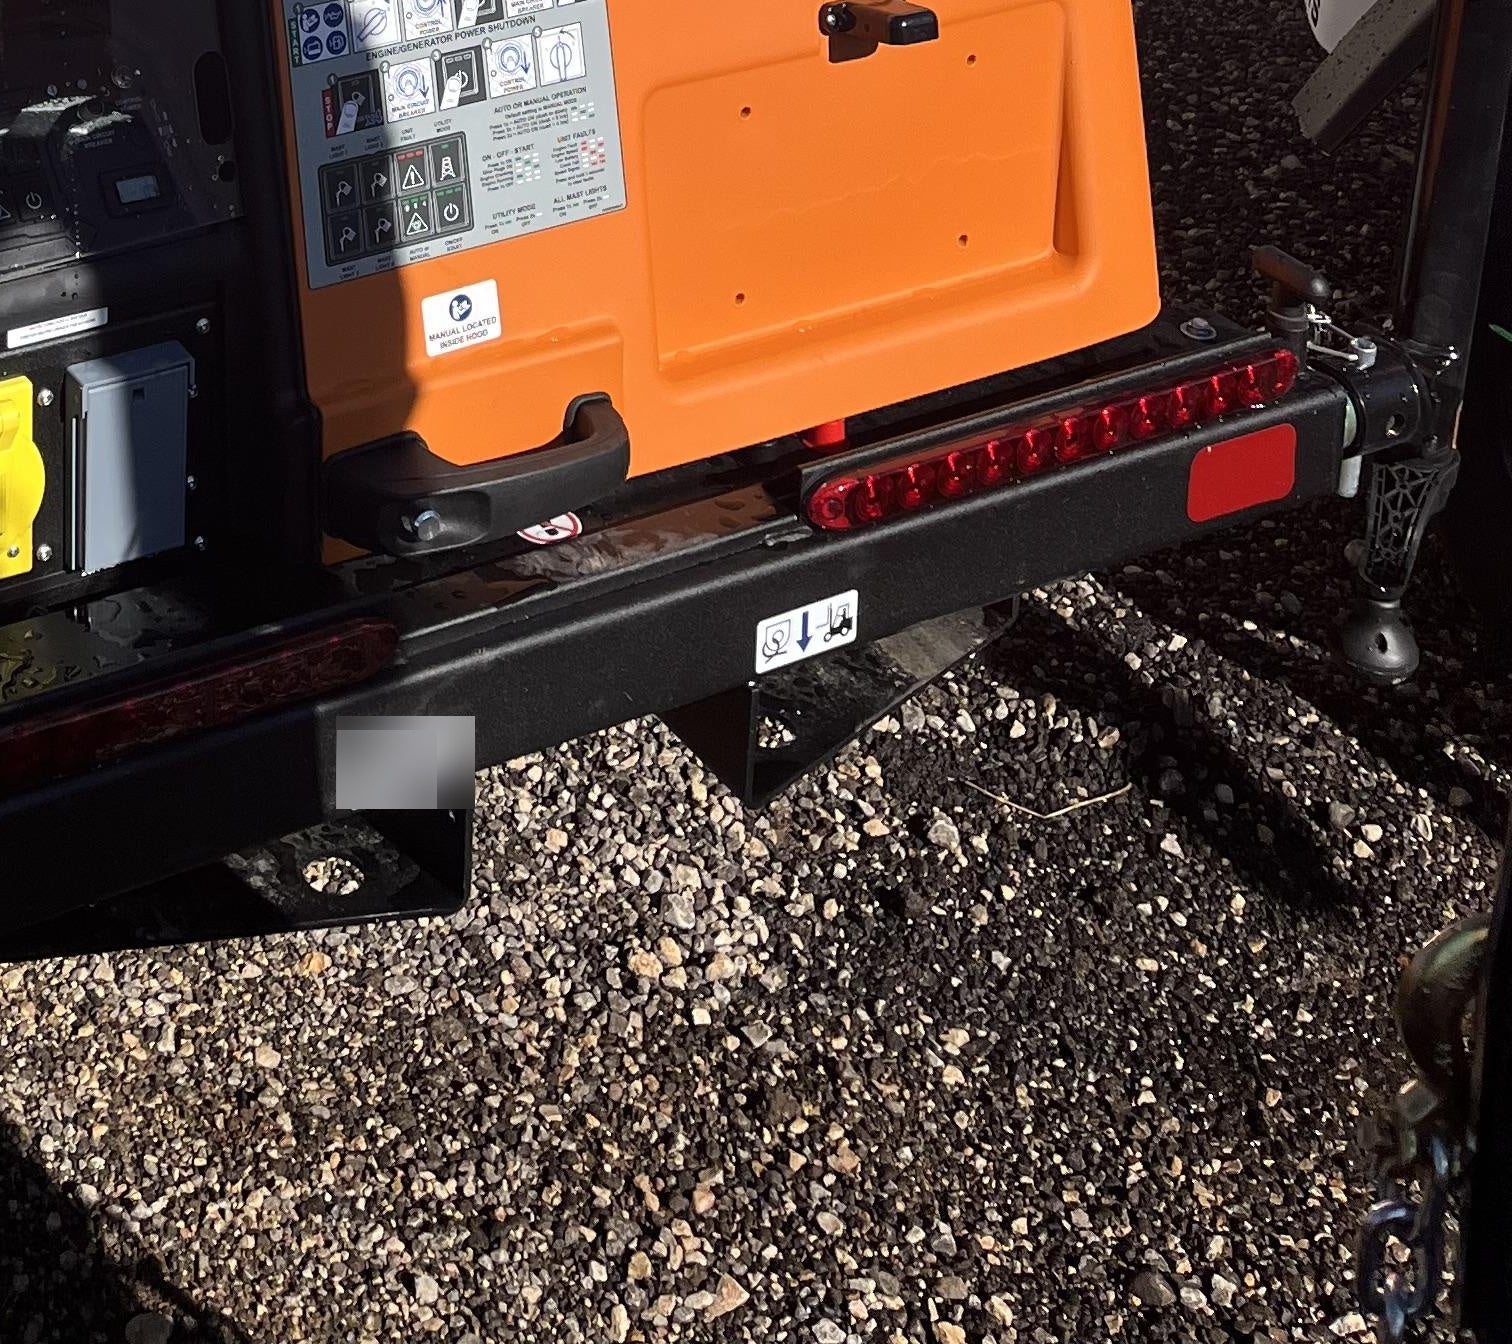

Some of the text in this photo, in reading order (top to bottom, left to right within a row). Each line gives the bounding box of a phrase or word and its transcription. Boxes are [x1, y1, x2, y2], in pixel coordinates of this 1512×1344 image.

[366, 14, 536, 61] ENGINE/GENERATOR POWER SHUTDOWN
[428, 316, 497, 342] MANUAL LOCATED
[439, 336, 465, 350] INSIDE
